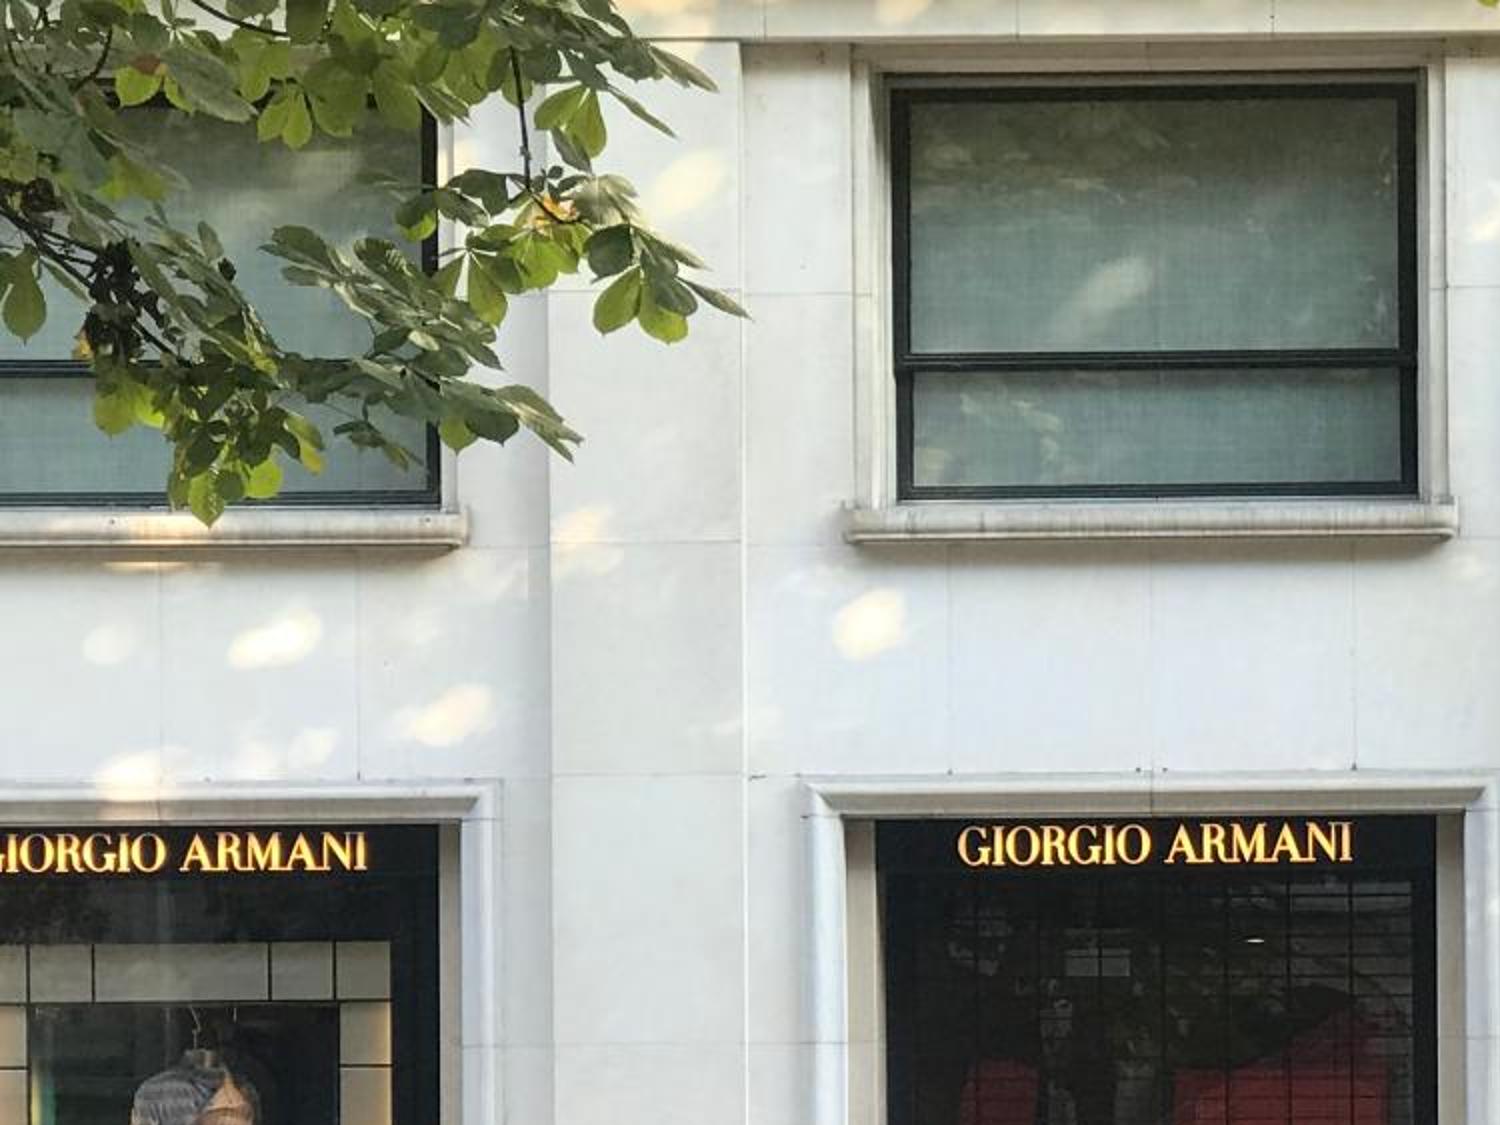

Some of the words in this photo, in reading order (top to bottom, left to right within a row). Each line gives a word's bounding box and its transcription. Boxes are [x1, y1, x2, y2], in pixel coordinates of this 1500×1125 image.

[0, 833, 167, 873] IORGIO
[179, 832, 367, 872] ARMANI
[958, 824, 1151, 866] GIORGIO
[1164, 822, 1352, 863] ARMANI
